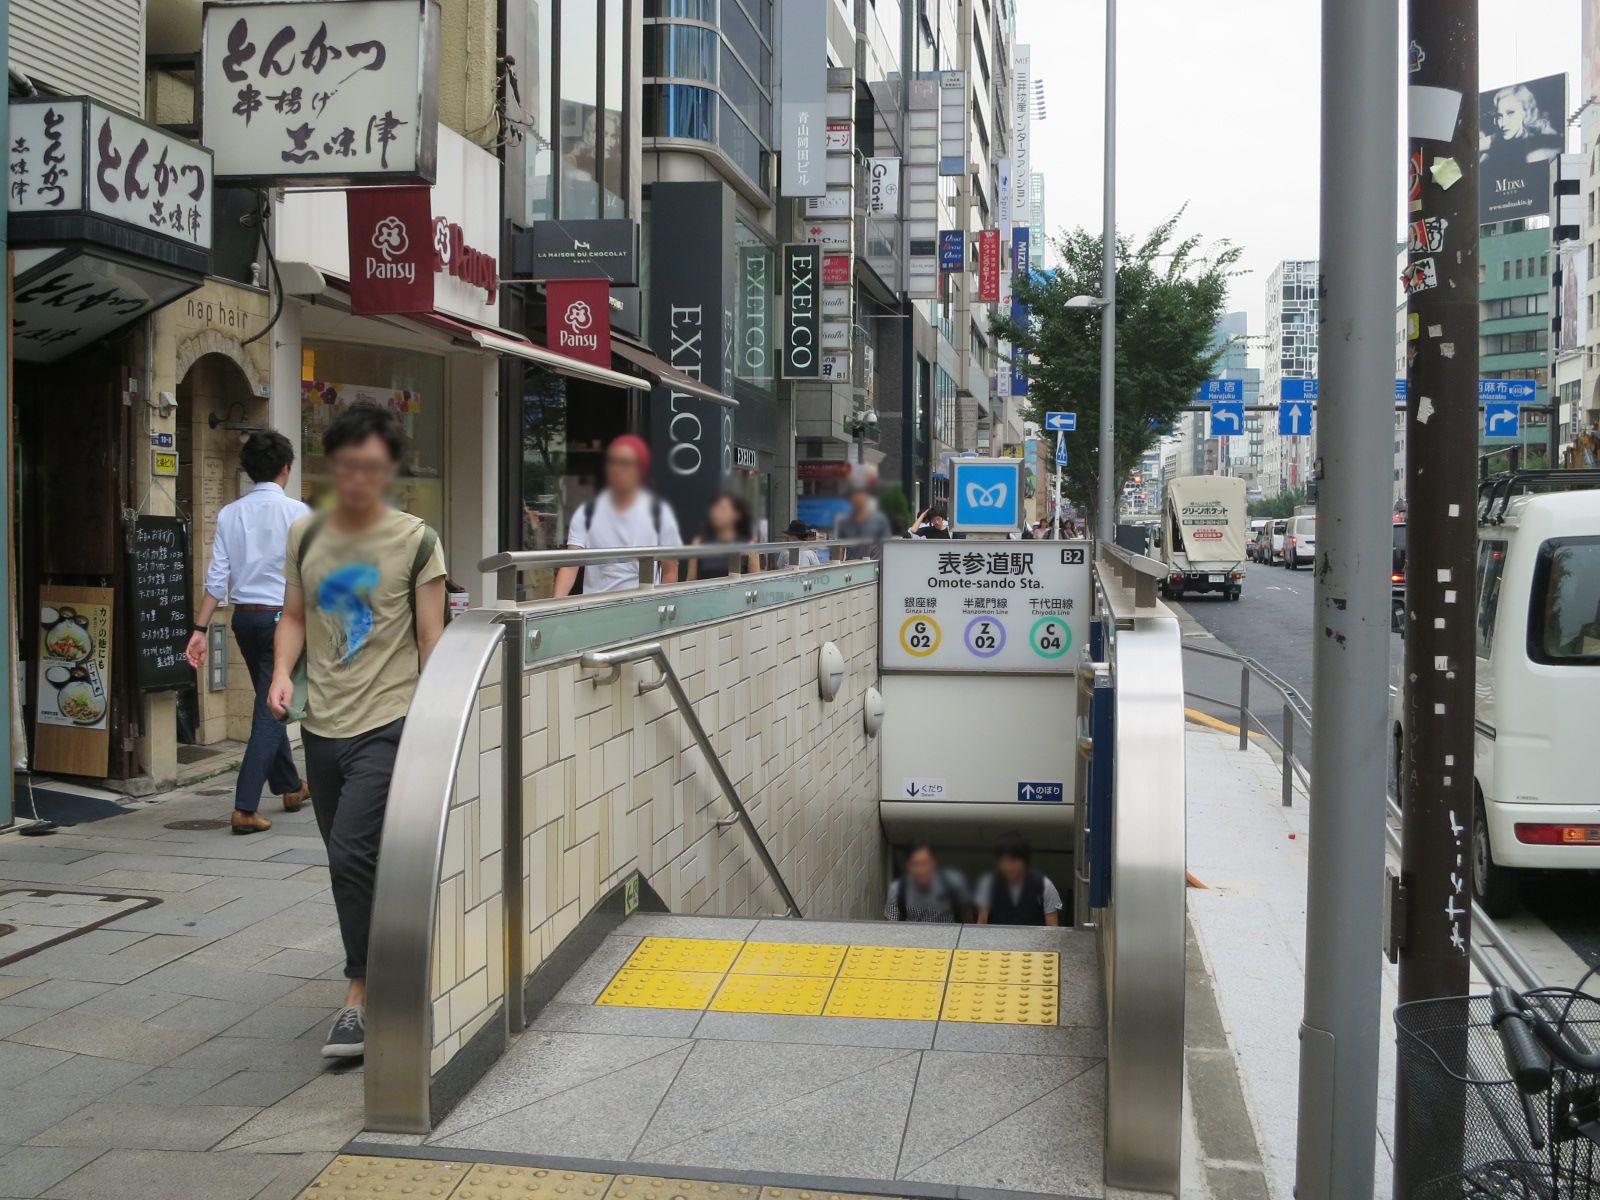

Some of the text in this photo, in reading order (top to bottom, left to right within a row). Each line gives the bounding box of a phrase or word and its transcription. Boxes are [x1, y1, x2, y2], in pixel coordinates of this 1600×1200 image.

[222, 17, 386, 84] とんかつ
[233, 84, 338, 127] 串揚げ
[797, 111, 810, 186] 青山岡田ビル
[38, 107, 68, 206] とんかつ
[96, 116, 205, 204] とんかつ
[1495, 178, 1525, 192] MDNA
[1017, 241, 1027, 277] MIZU
[366, 257, 416, 285] Pansy
[187, 299, 249, 329] nap hair
[791, 254, 812, 369] EXELCO
[559, 330, 597, 351] Pansy
[1208, 381, 1236, 392] 原宿
[1303, 381, 1318, 392] 日
[1208, 392, 1236, 400] Harajuku
[737, 448, 756, 467] EXELCO
[1182, 507, 1228, 515] グリーンポケット
[1063, 550, 1082, 563] B2
[938, 551, 1034, 576] 表参道駅
[927, 577, 1045, 589] Omote-sando Sta.
[904, 597, 937, 608] 銀座線
[963, 597, 1008, 609] 半蔵門線
[1029, 598, 1073, 609] 千代田線
[914, 622, 926, 634] G
[980, 623, 990, 634] Z
[1046, 623, 1056, 635] C
[98, 607, 107, 670] カツの他にも
[910, 635, 930, 648] 02
[975, 636, 995, 649] 02
[1040, 637, 1061, 649] 04
[921, 784, 943, 793] くだり
[1035, 786, 1060, 795] のぼり
